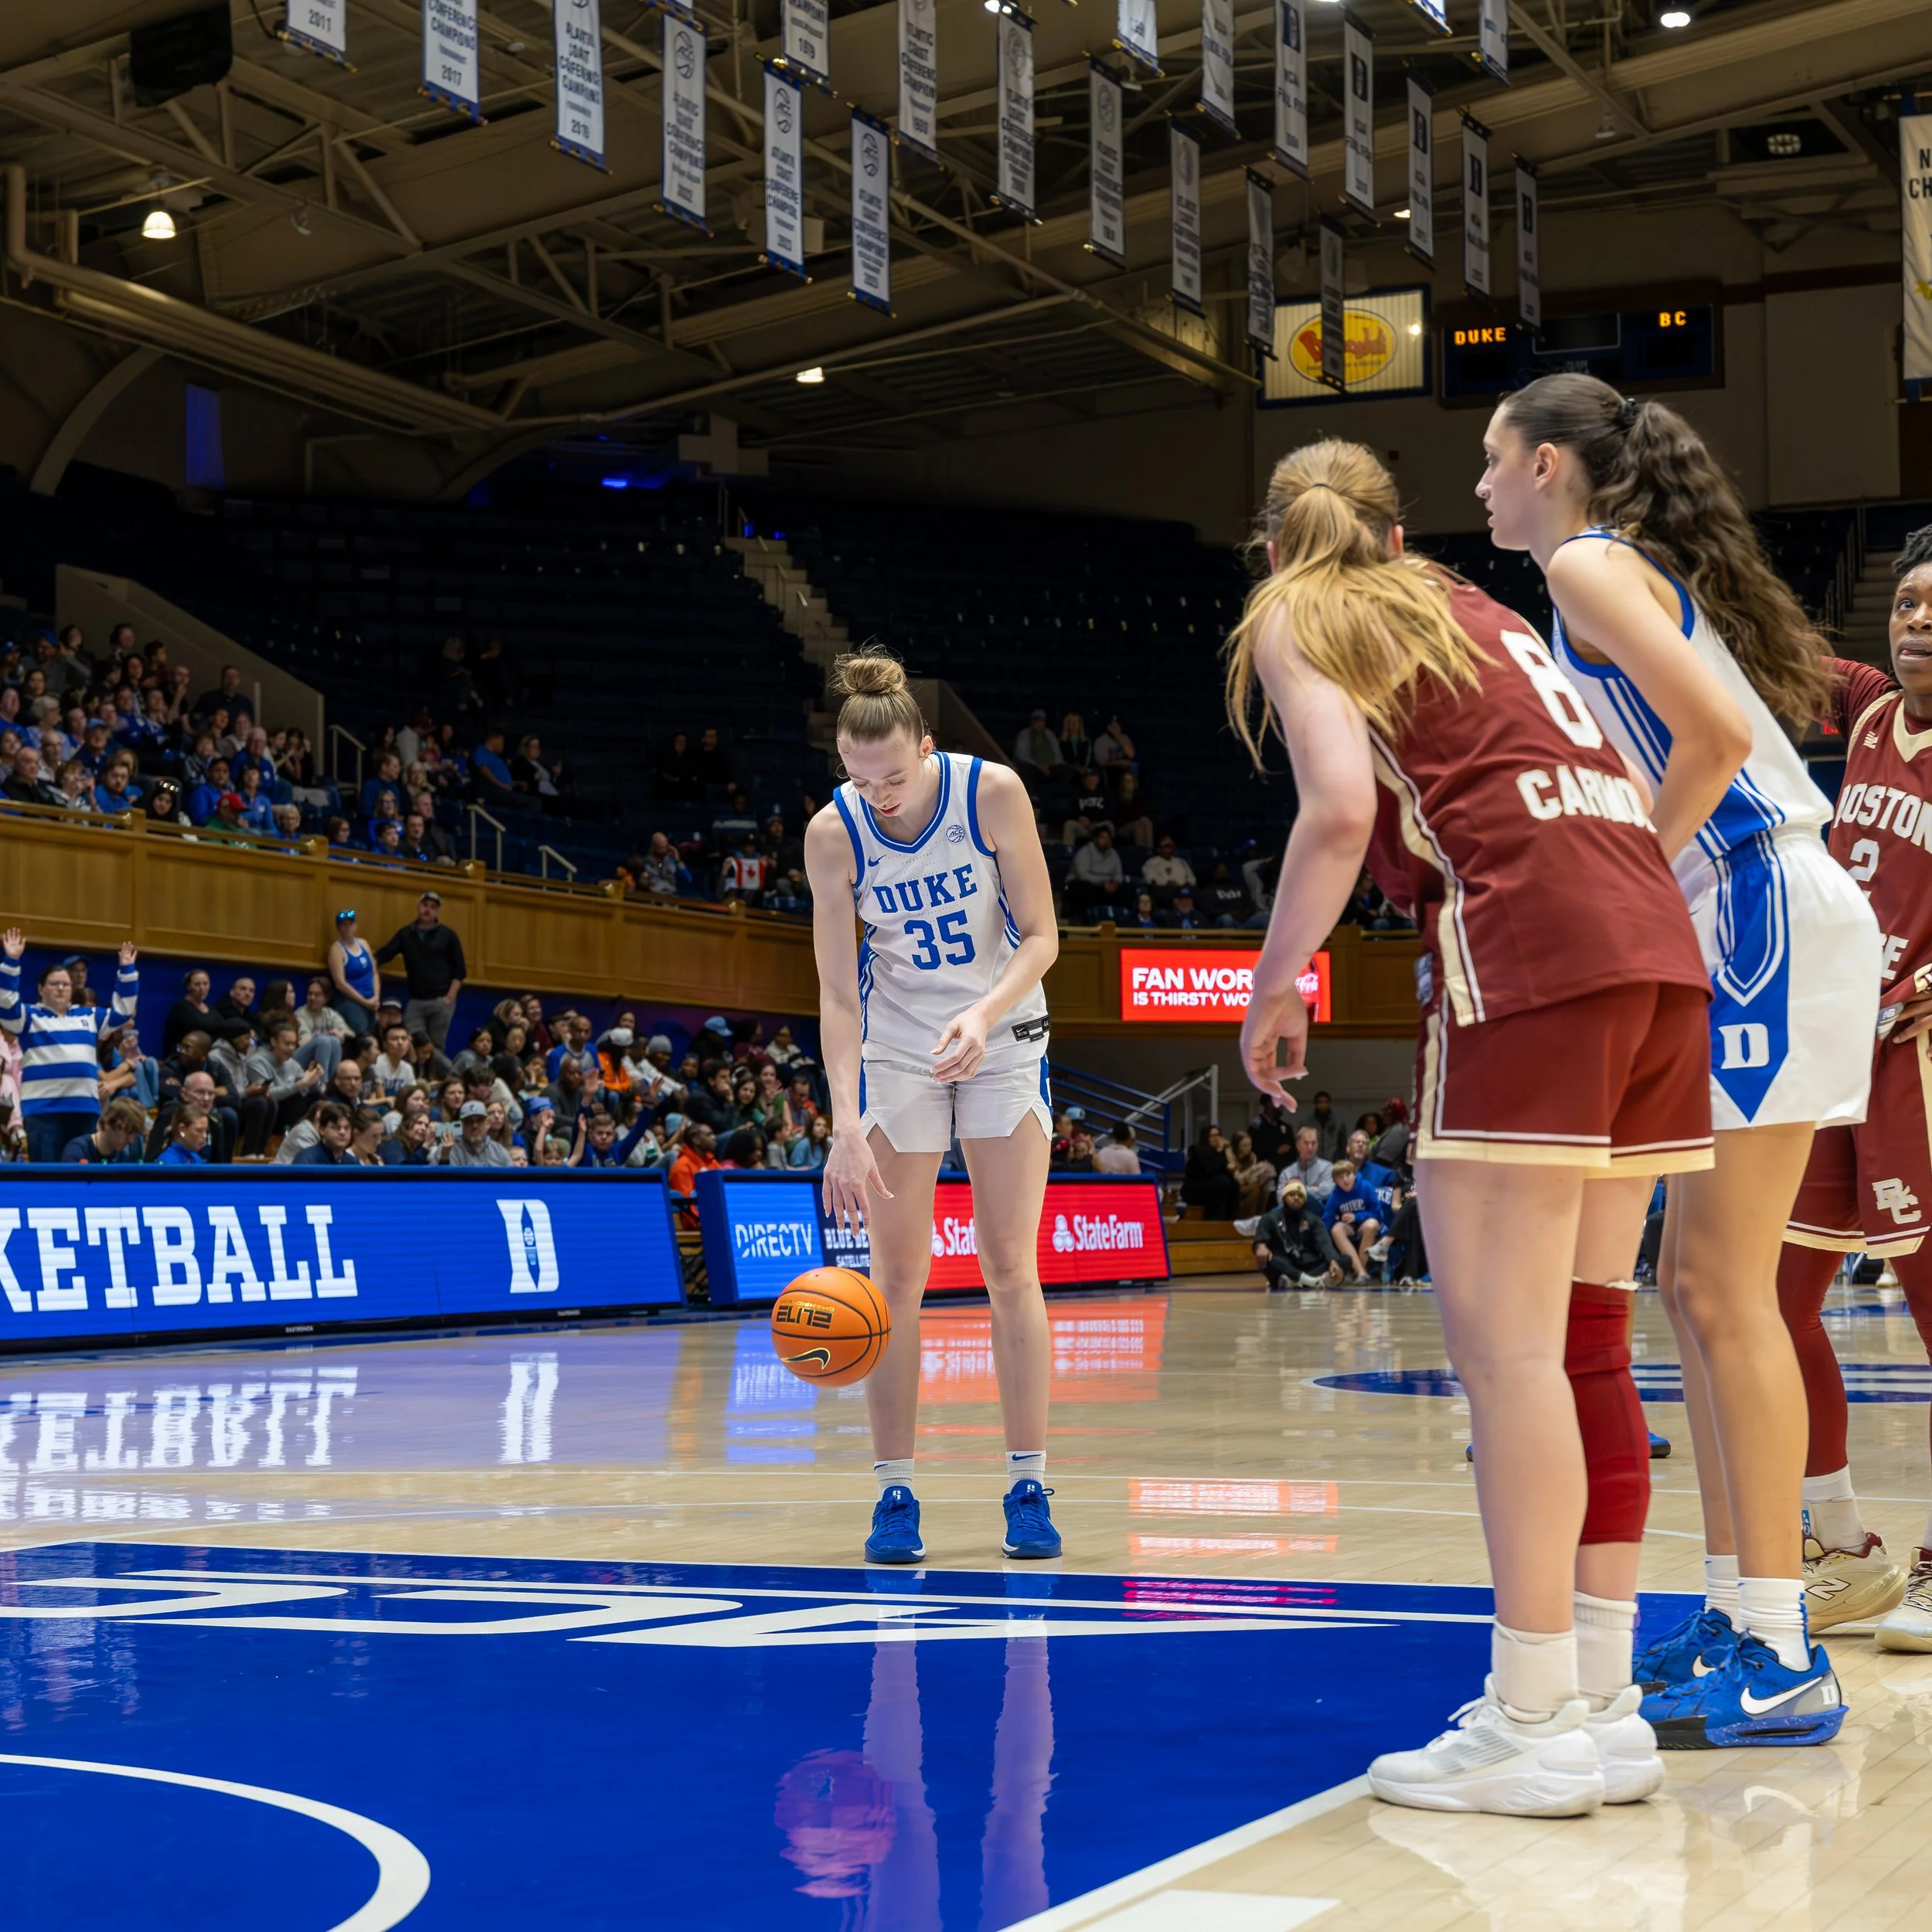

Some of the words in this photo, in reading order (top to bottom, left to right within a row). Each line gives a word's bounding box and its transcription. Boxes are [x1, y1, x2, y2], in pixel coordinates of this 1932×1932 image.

[308, 9, 332, 32] 2011
[441, 64, 463, 87] 2017
[1658, 311, 1687, 327] BC
[1454, 327, 1507, 345] DUKE
[1500, 628, 1604, 750] 8
[872, 862, 978, 914] DUKE
[903, 909, 977, 971] 35
[1132, 968, 1184, 990] FAN
[1189, 968, 1255, 991] WOR
[1133, 992, 1148, 1006] IS
[1153, 992, 1220, 1006] THIRSTY
[1717, 1022, 1770, 1070] D
[1871, 1177, 1922, 1225] BC
[496, 1198, 560, 1294] D
[734, 1223, 812, 1259] DIRECTV
[824, 1227, 854, 1250] BLUE
[776, 1304, 834, 1330] ELITE
